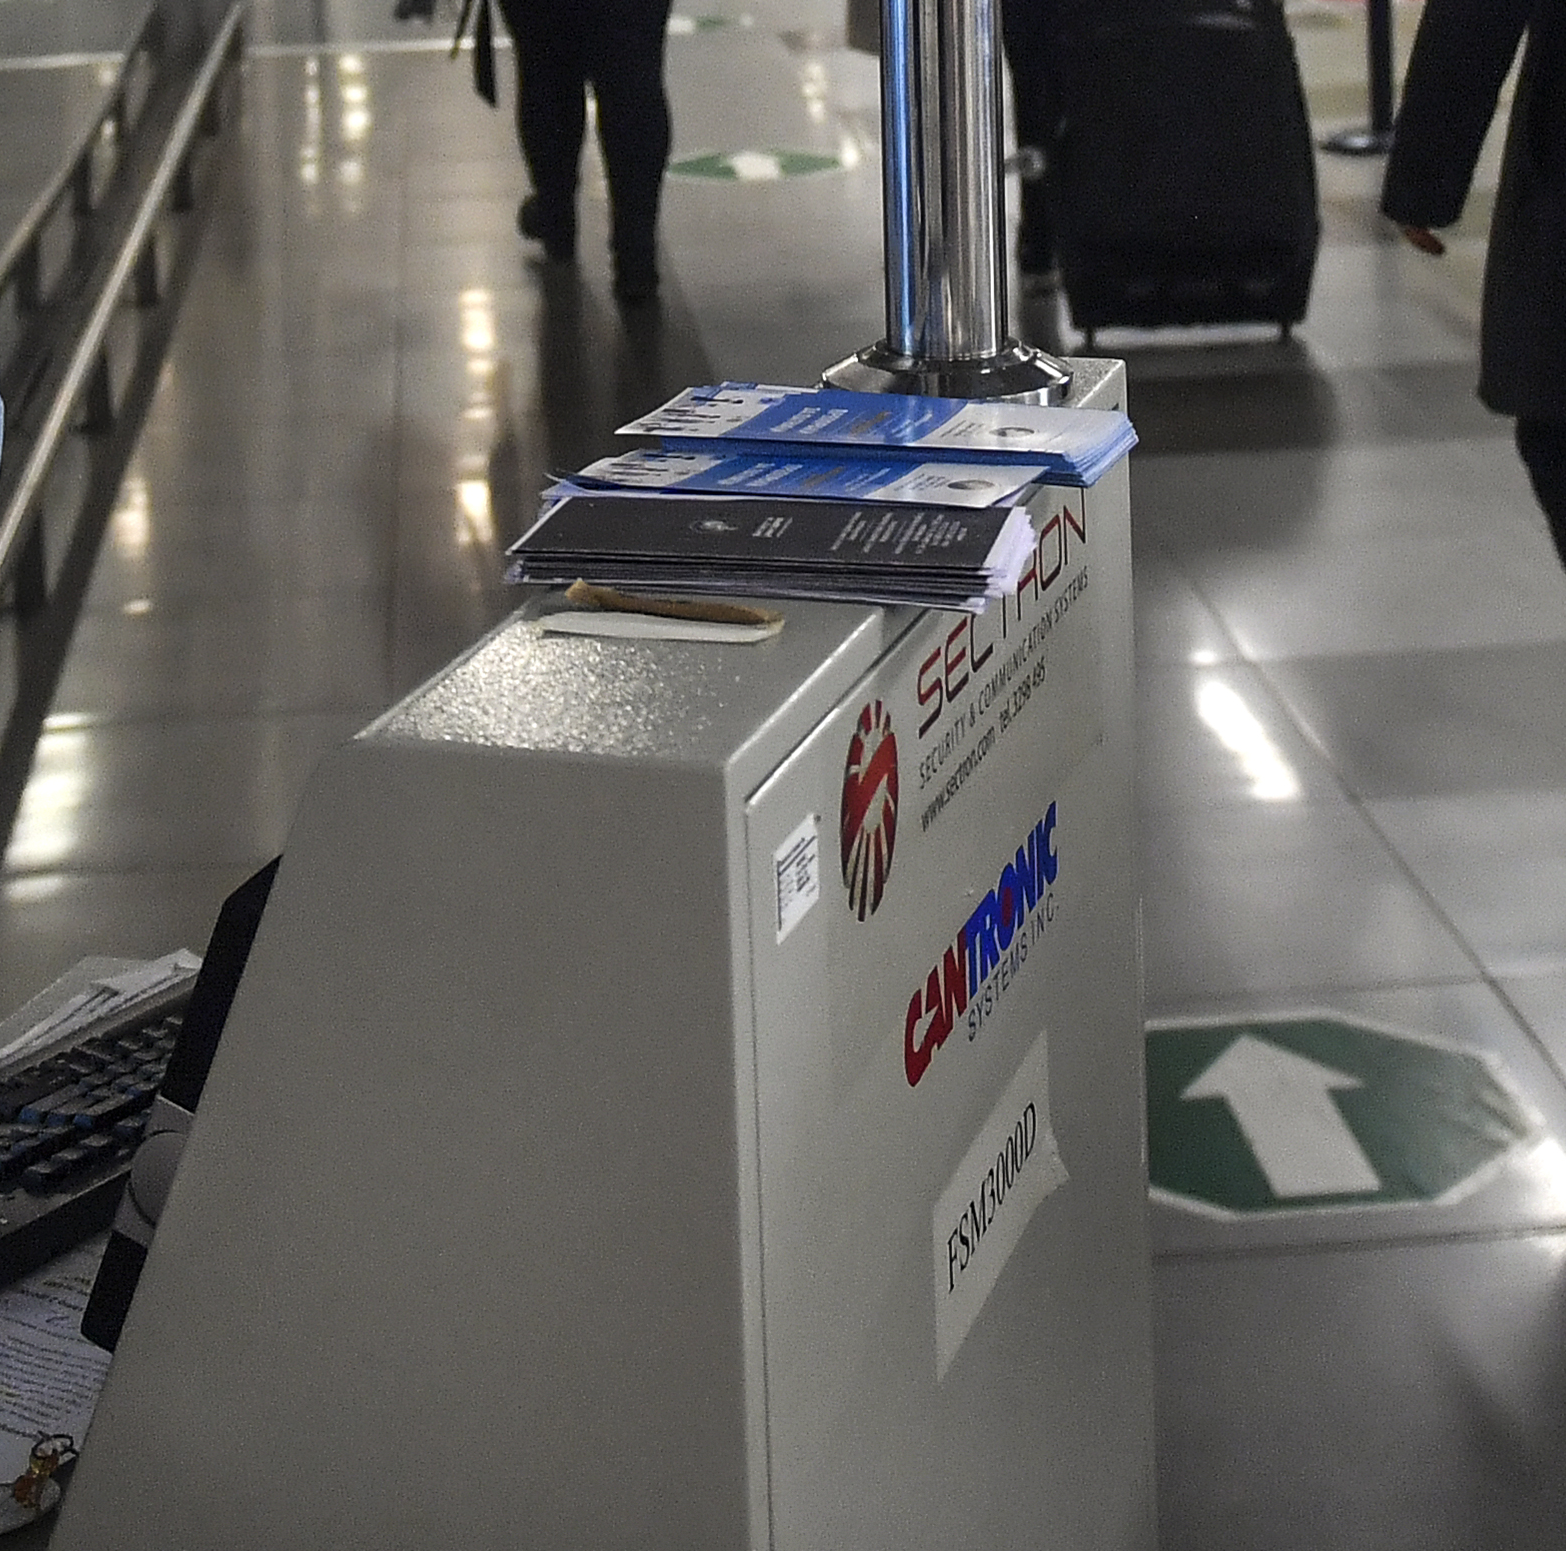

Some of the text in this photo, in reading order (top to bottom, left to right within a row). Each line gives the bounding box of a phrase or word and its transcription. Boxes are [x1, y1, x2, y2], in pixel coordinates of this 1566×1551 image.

[919, 564, 1089, 790] SECURITY & COMMUNICATION SYSTEMS
[921, 725, 995, 833] www.sectron.com
[905, 800, 1058, 1088] CANTRONIC
[967, 892, 1060, 1043] SYSTEMS INC.
[946, 1101, 1039, 1294] FSM3000D
